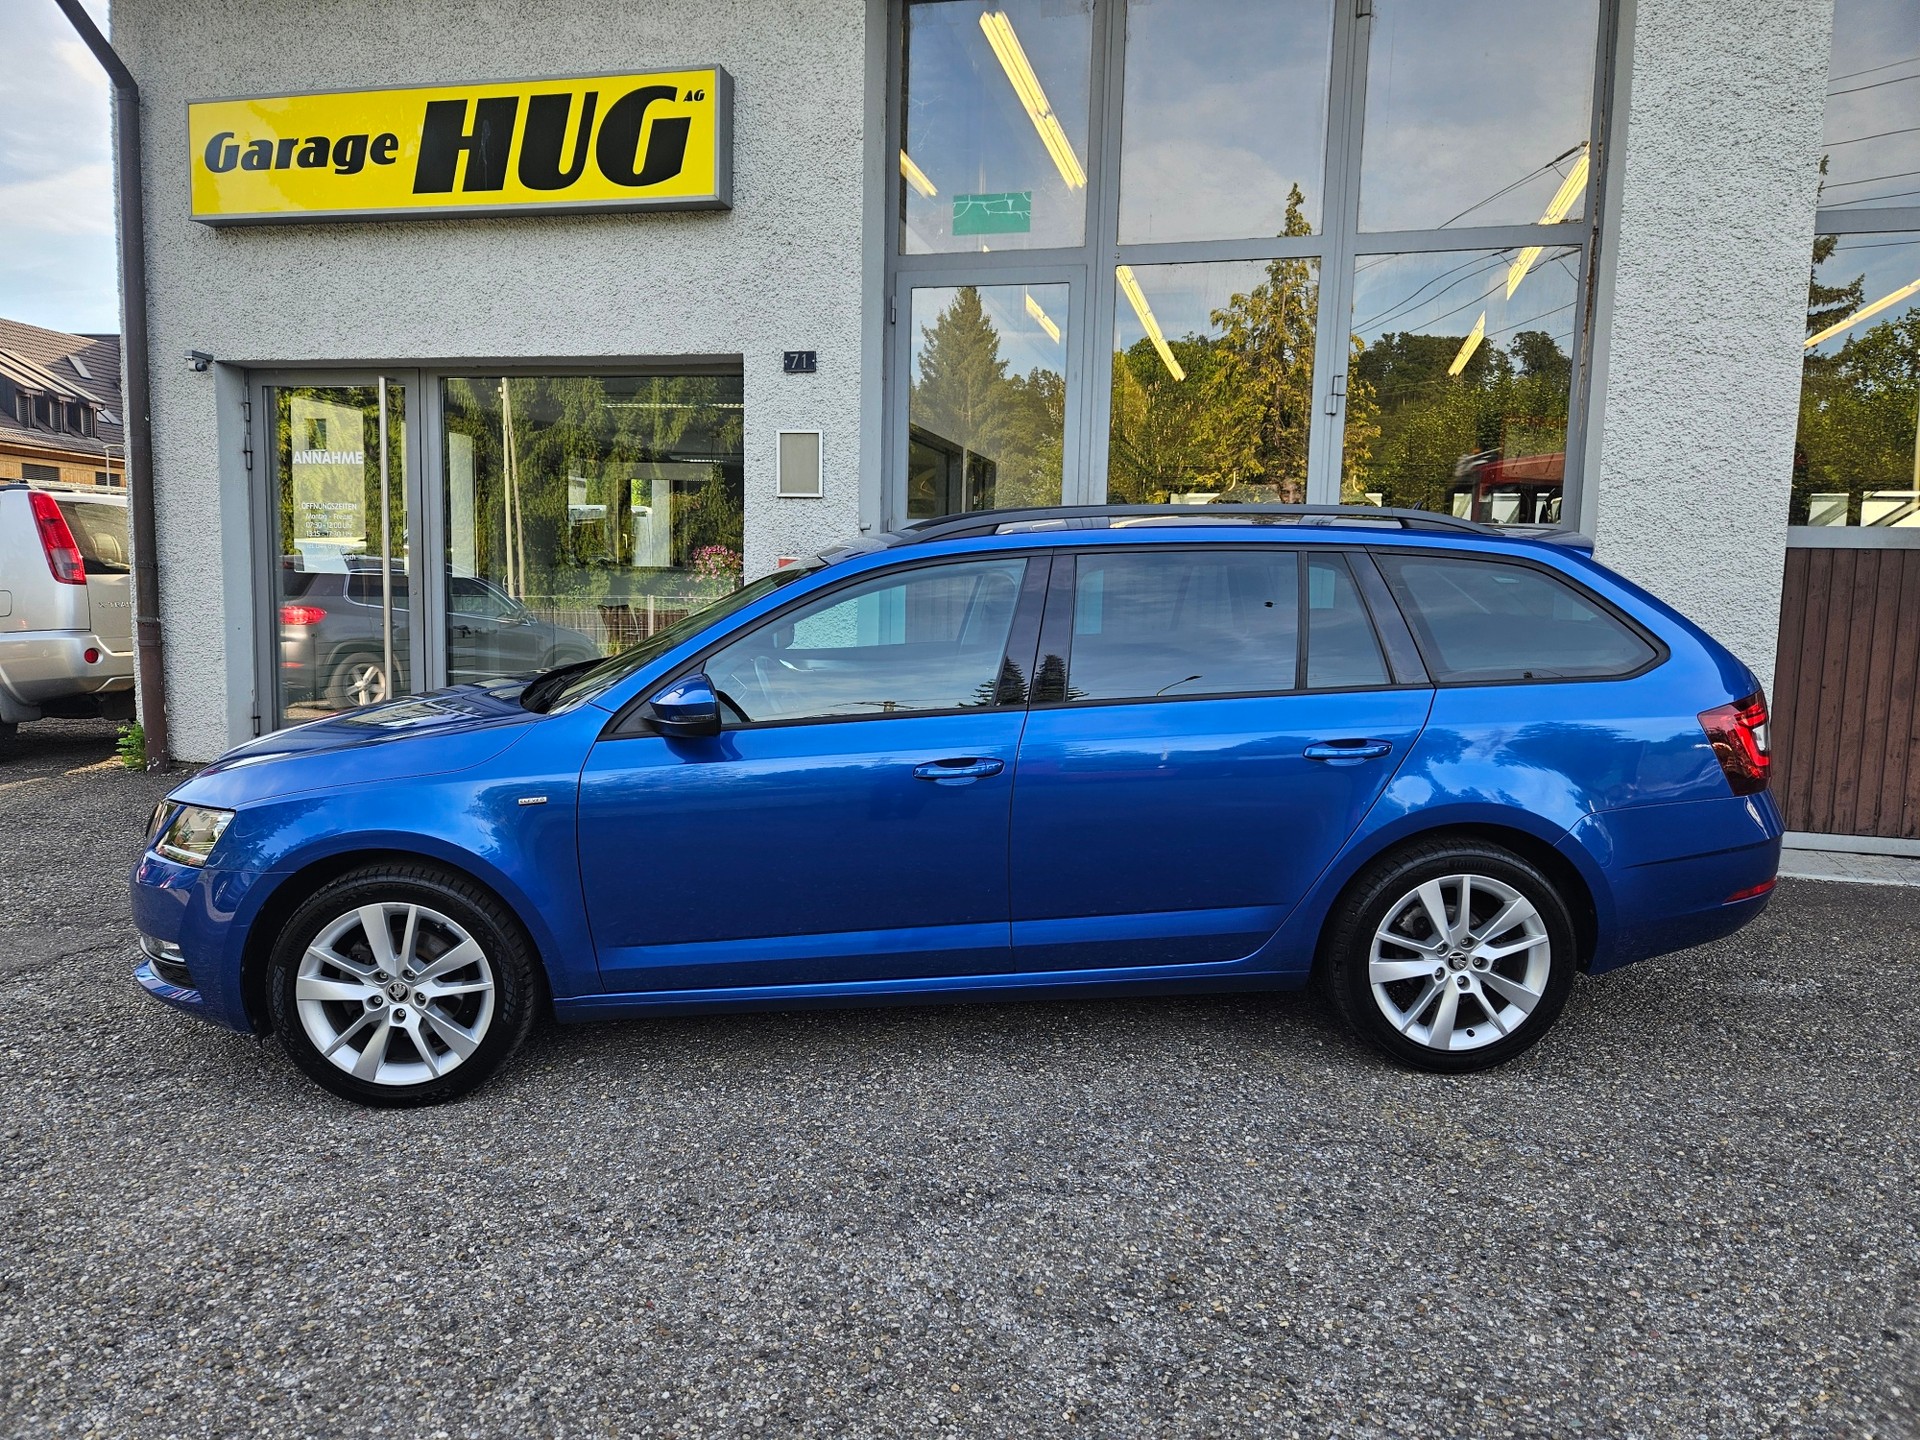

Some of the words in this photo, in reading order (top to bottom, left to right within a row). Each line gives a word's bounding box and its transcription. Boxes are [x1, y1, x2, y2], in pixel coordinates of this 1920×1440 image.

[204, 131, 399, 175] Garage
[412, 85, 692, 194] HUG
[683, 89, 705, 102] AG
[789, 354, 807, 368] 71
[293, 451, 364, 465] ANNAHME
[305, 513, 328, 521] Montag
[98, 601, 131, 609] X-TRAI
